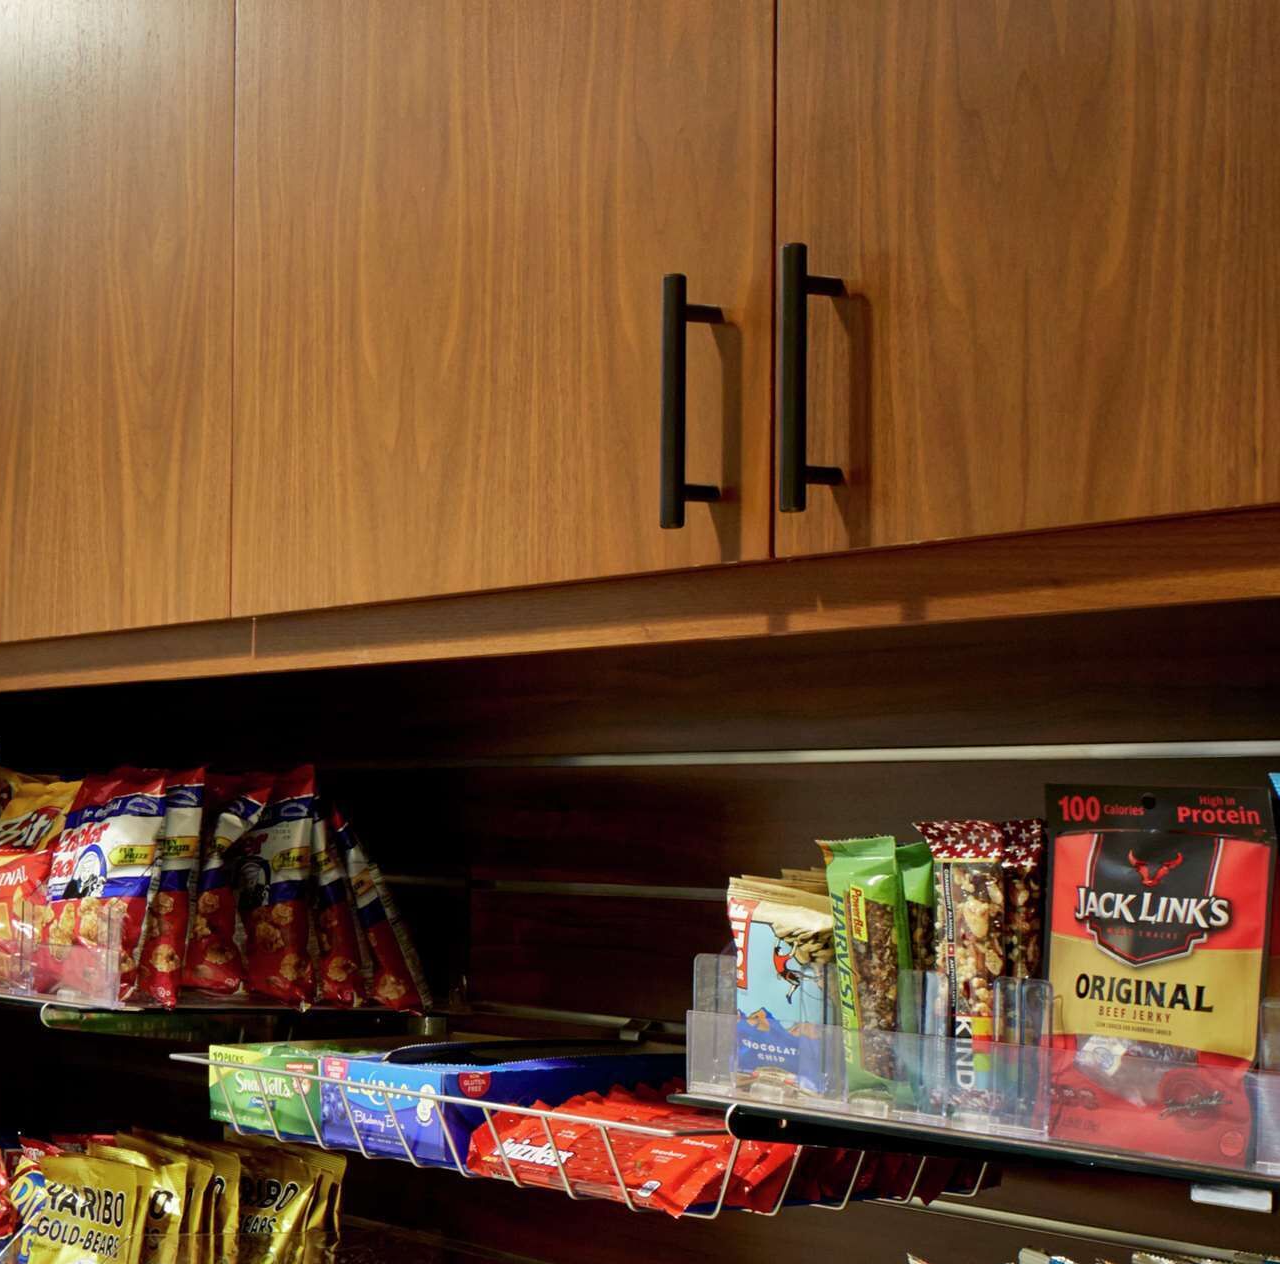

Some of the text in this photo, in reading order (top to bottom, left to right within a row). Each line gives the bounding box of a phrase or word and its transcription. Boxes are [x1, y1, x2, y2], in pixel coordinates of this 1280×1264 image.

[1057, 795, 1145, 823] 100 Calories
[1176, 805, 1261, 826] Protein
[850, 886, 867, 941] PowerBar
[943, 868, 955, 940] CRANBERRY ALMOND
[1074, 886, 1231, 930] JACK LINK'S
[830, 891, 856, 1018] HARVEST
[1075, 973, 1214, 1014] ORIGINAL
[1098, 1005, 1172, 1025] BEEF JERKY
[742, 1037, 798, 1057] CHOCOLAT
[757, 1052, 786, 1064] CHIP
[955, 1015, 976, 1090] KIND
[46, 1182, 126, 1228] HARIBO
[36, 1216, 120, 1259] GOLD-BEARS
